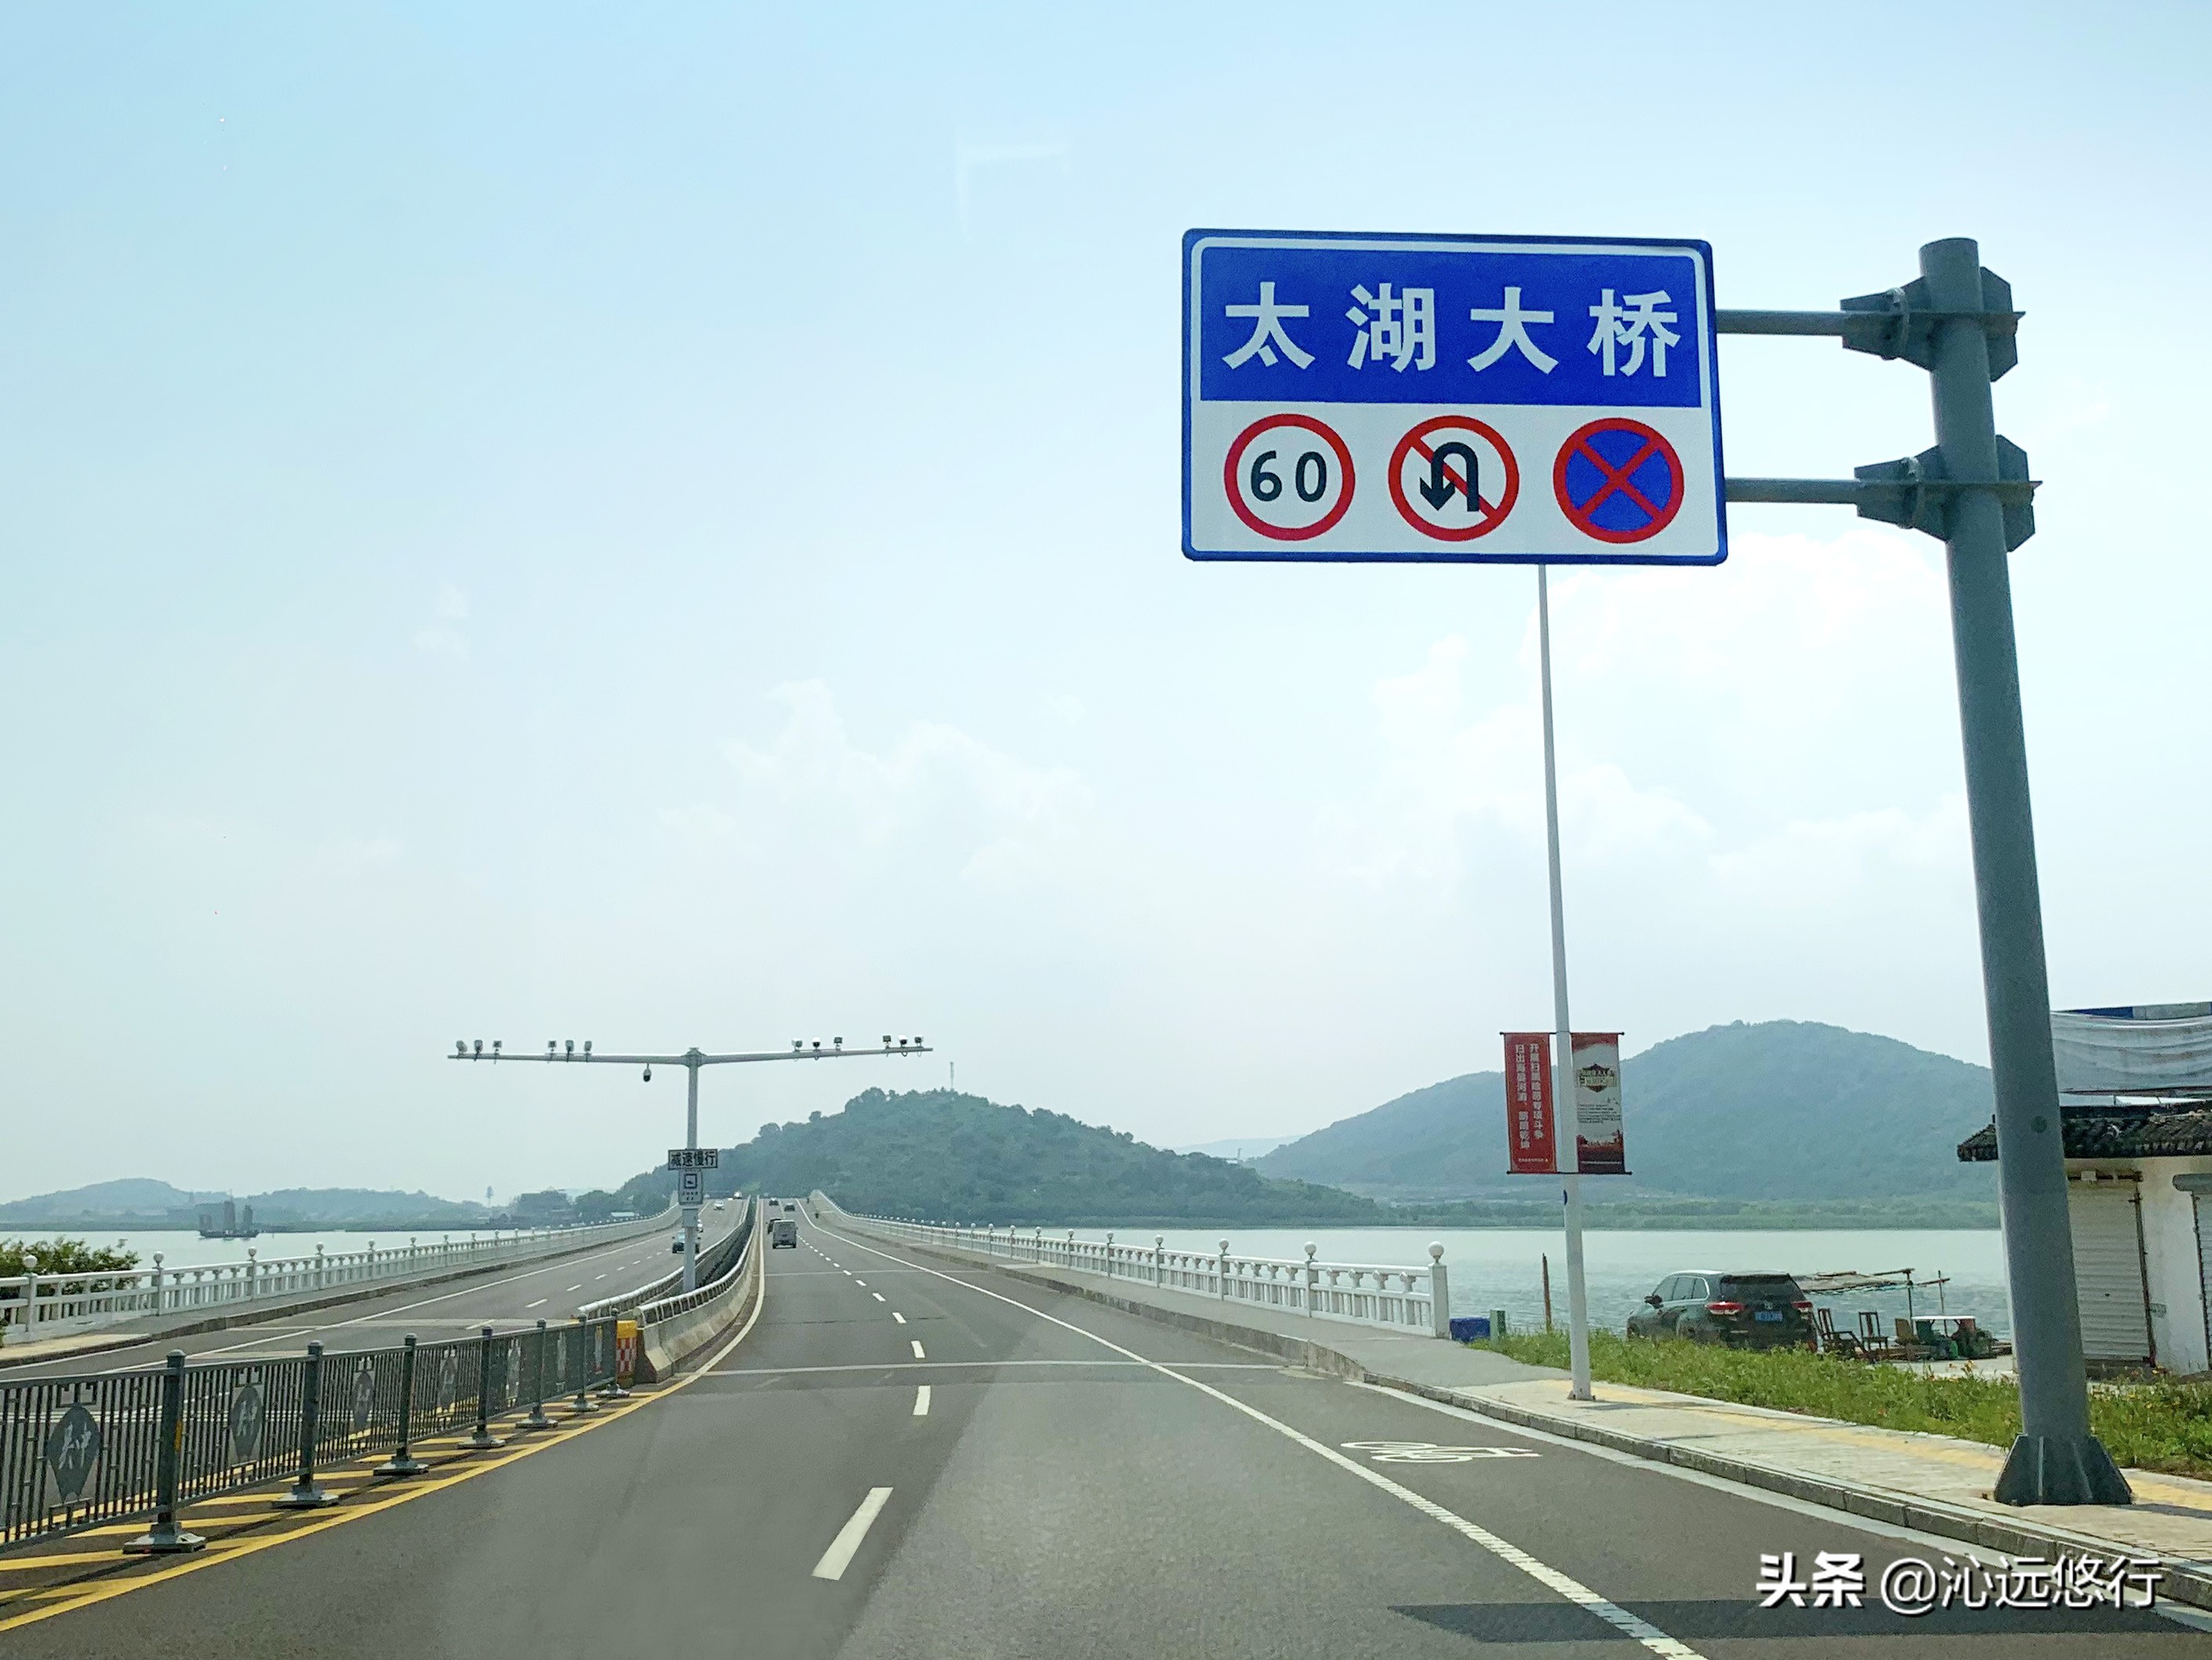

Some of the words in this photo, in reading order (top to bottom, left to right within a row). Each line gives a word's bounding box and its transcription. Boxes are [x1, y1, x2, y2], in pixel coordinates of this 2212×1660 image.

[1222, 281, 1681, 378] 太湖大桥
[1251, 449, 1328, 503] 60
